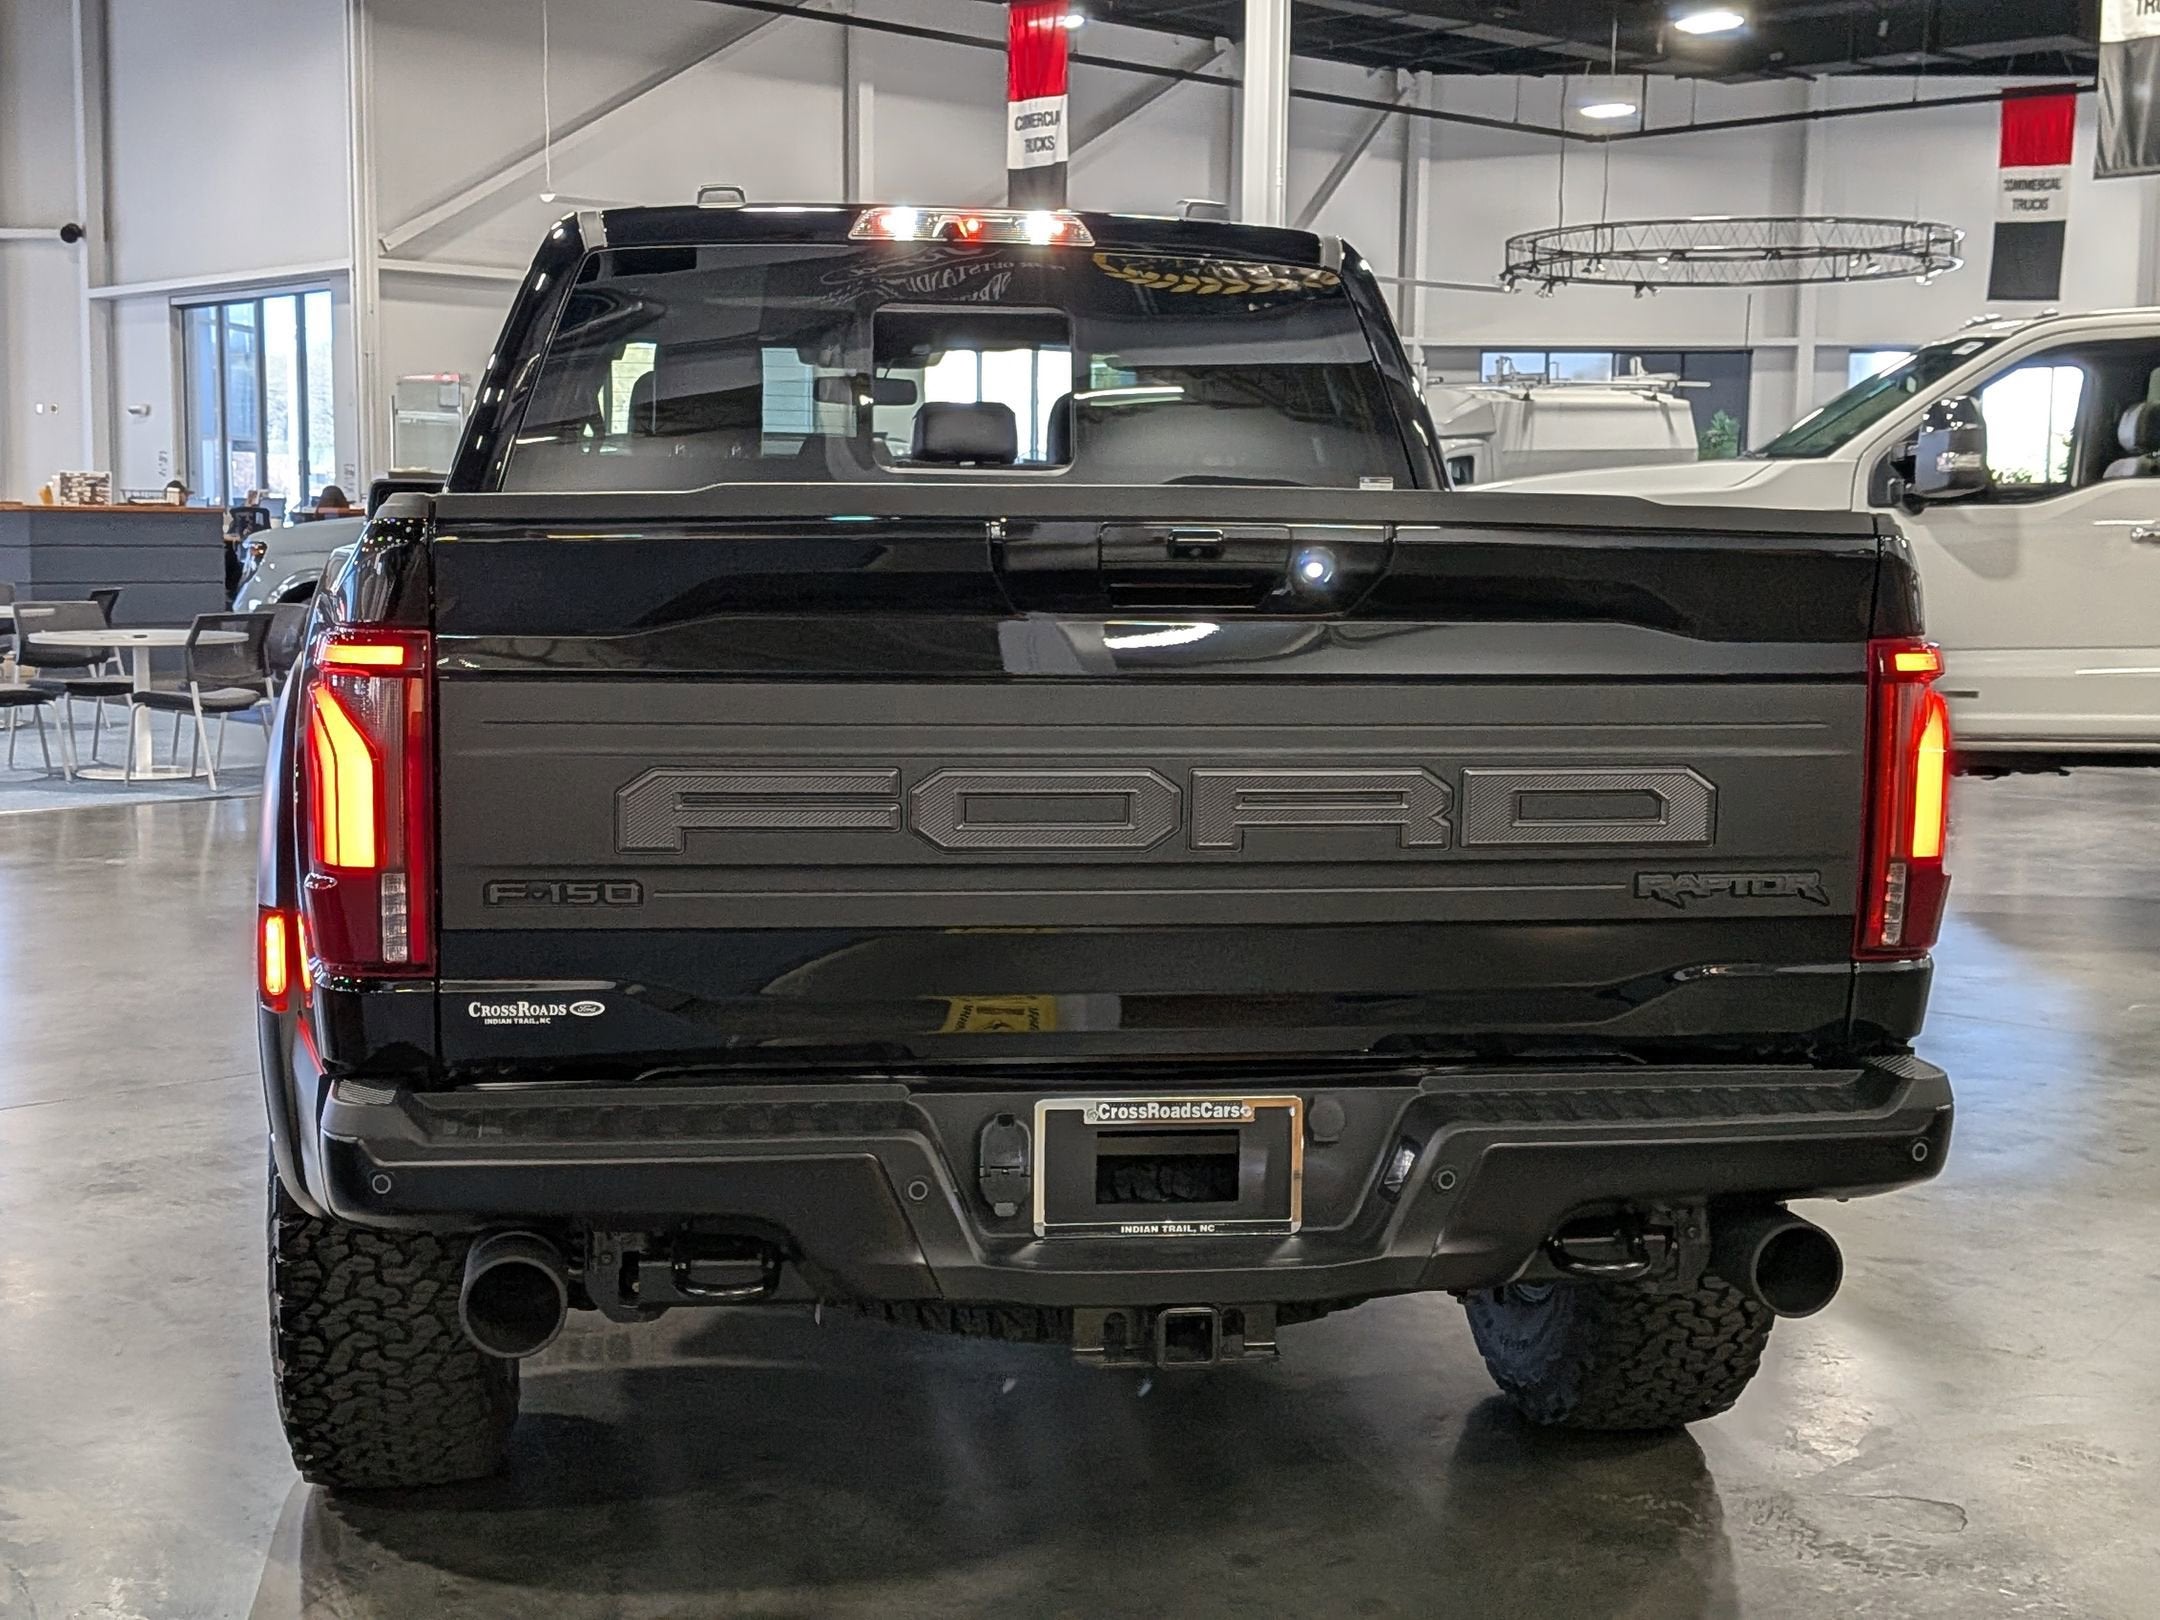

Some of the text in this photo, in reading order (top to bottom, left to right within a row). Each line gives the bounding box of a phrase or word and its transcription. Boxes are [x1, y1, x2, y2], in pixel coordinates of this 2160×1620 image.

[2136, 0, 2160, 15] TR
[615, 767, 1718, 853] FORD
[486, 881, 642, 905] F-150
[1635, 871, 1830, 909] RAPTOR
[1099, 1102, 1241, 1120] CrossRoadsCars
[1120, 1224, 1215, 1233] INDIAN TRAIL, NC
